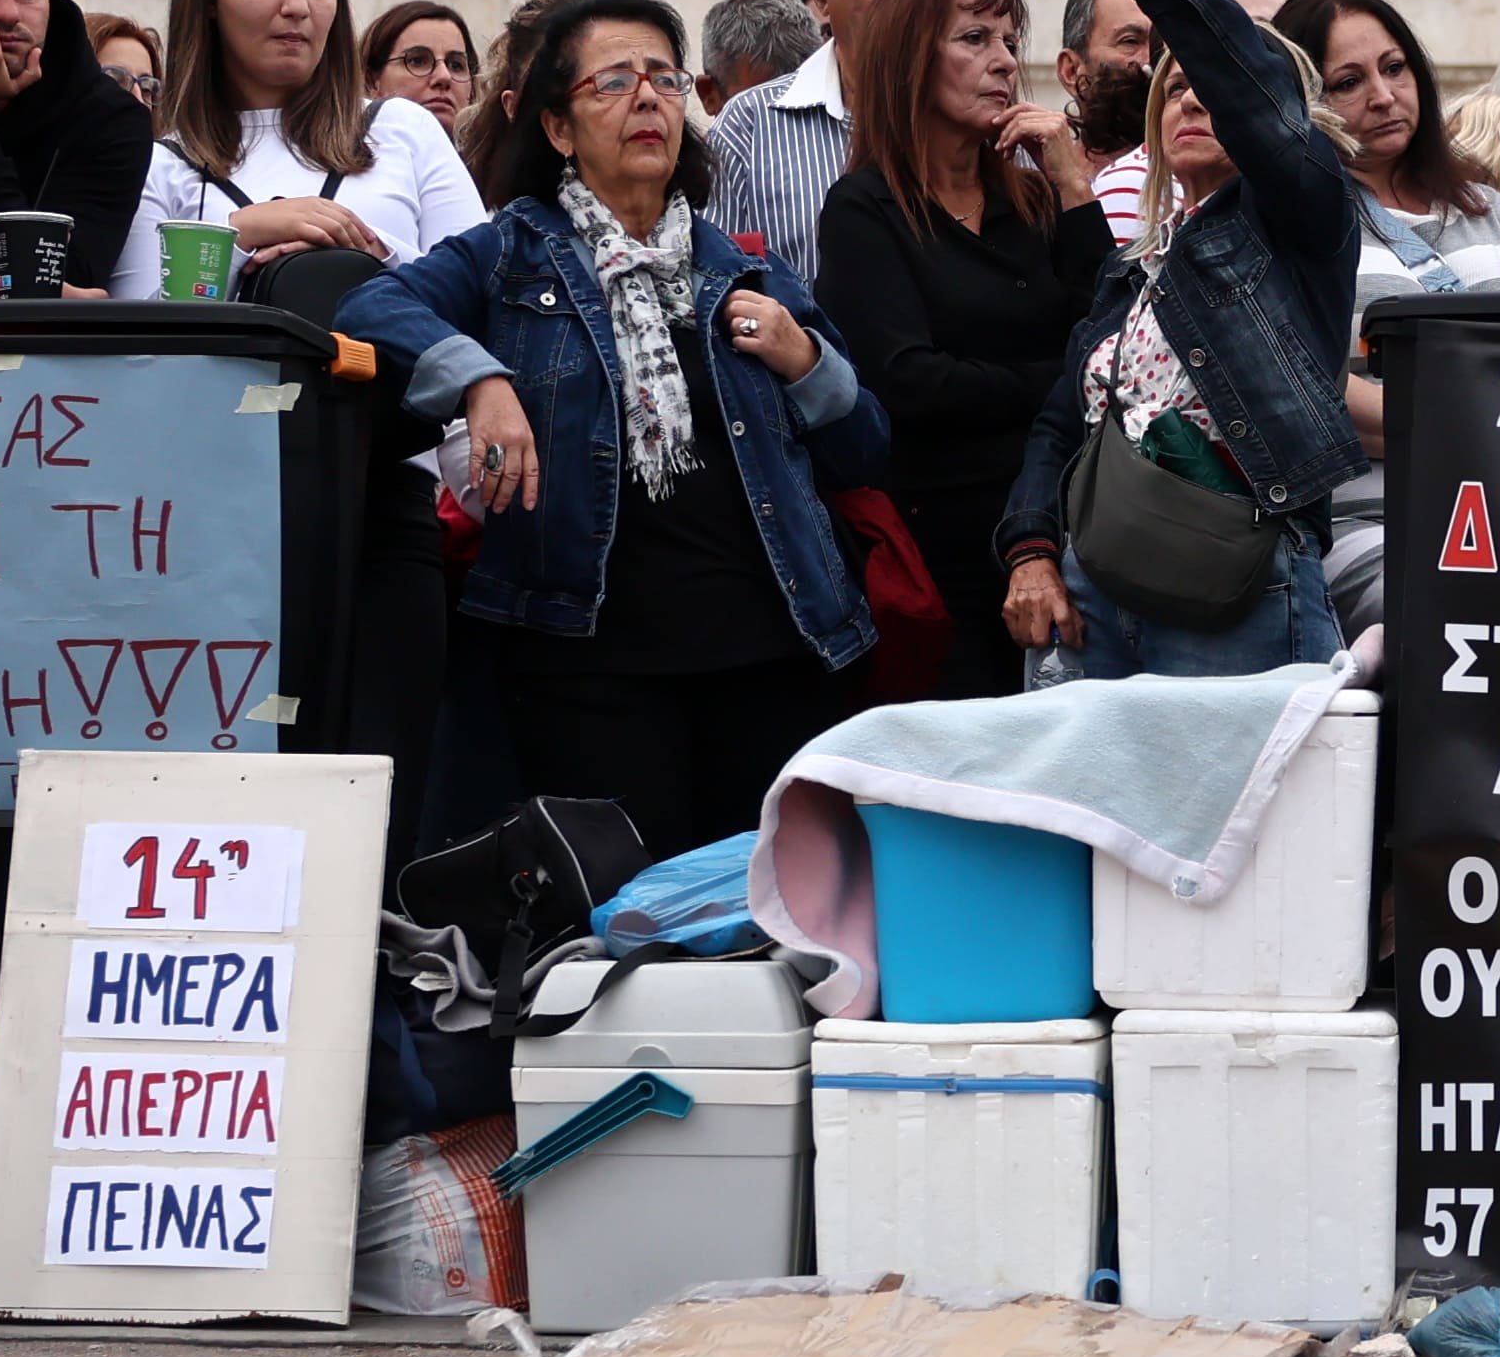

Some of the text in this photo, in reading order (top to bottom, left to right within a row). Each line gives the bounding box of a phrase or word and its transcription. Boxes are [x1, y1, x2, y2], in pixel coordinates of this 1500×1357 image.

[50, 495, 174, 579] ΤΗ
[86, 951, 279, 1033] ΗΜΕΡΑ
[62, 1065, 276, 1144] ΑΠΕΡΓΙΑ
[60, 1182, 274, 1255] ΠΕΙΝΑΣ
[1422, 1187, 1495, 1258] 57
